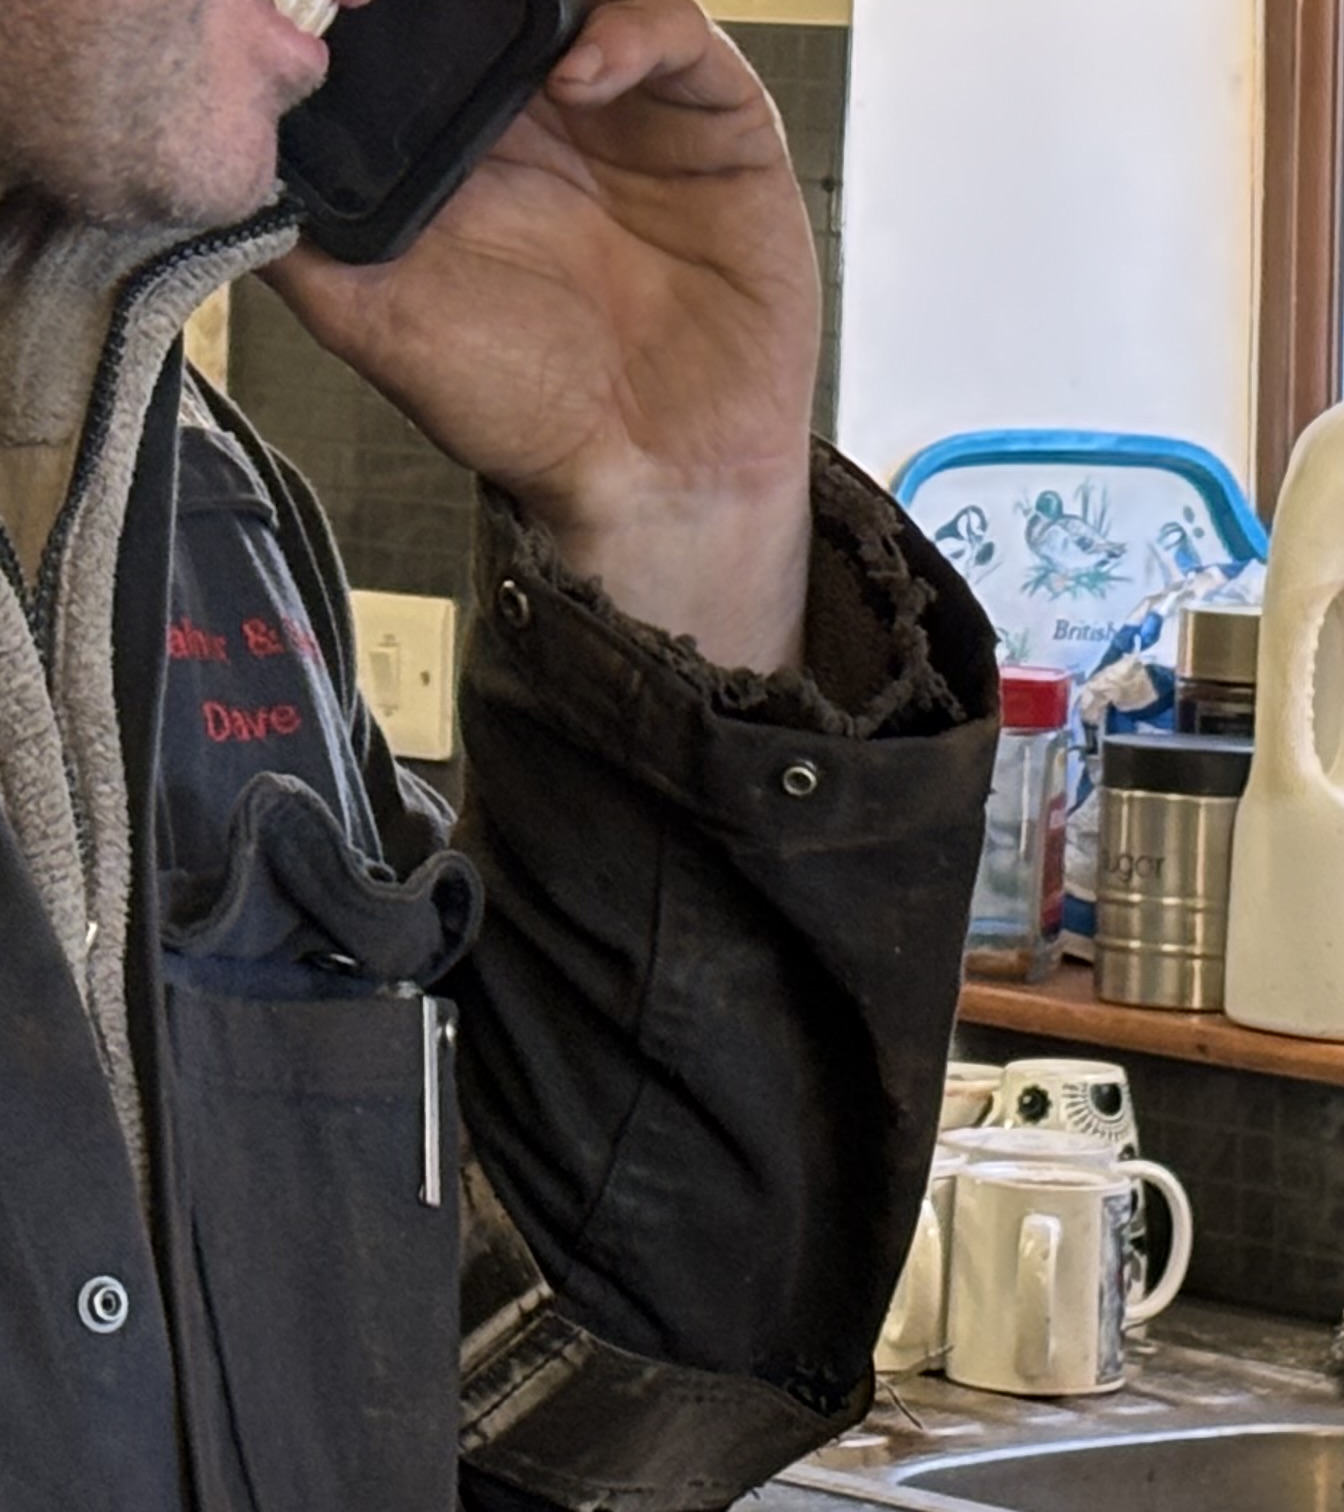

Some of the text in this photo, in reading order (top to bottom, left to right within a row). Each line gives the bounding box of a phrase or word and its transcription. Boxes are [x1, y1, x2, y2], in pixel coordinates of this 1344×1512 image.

[1053, 618, 1118, 642] British
[203, 701, 302, 742] Dave
[1101, 848, 1166, 885] ugar
